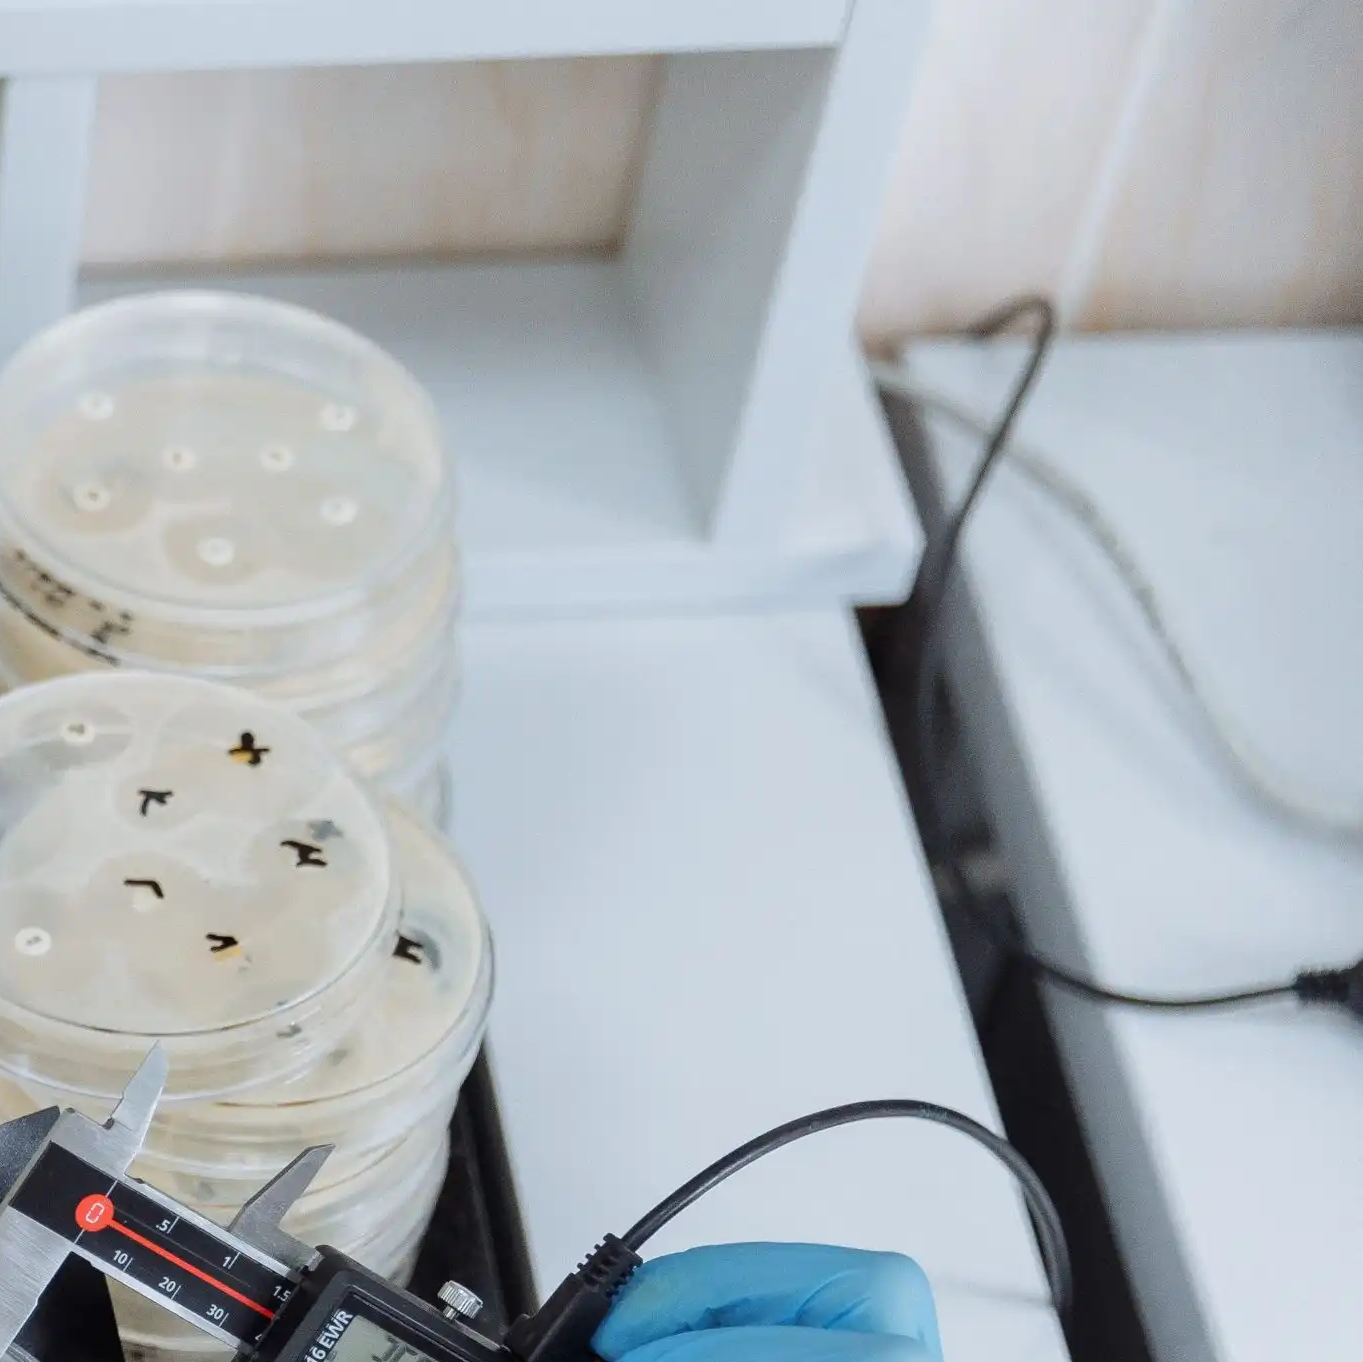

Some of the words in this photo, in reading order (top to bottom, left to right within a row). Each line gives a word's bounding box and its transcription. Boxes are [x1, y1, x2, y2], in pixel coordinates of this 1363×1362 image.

[85, 1202, 105, 1224] 0
[113, 1250, 128, 1265] 10
[223, 1257, 231, 1269] 1
[159, 1276, 176, 1292] 20
[206, 1304, 224, 1320] 30
[319, 1309, 353, 1349] EWR
